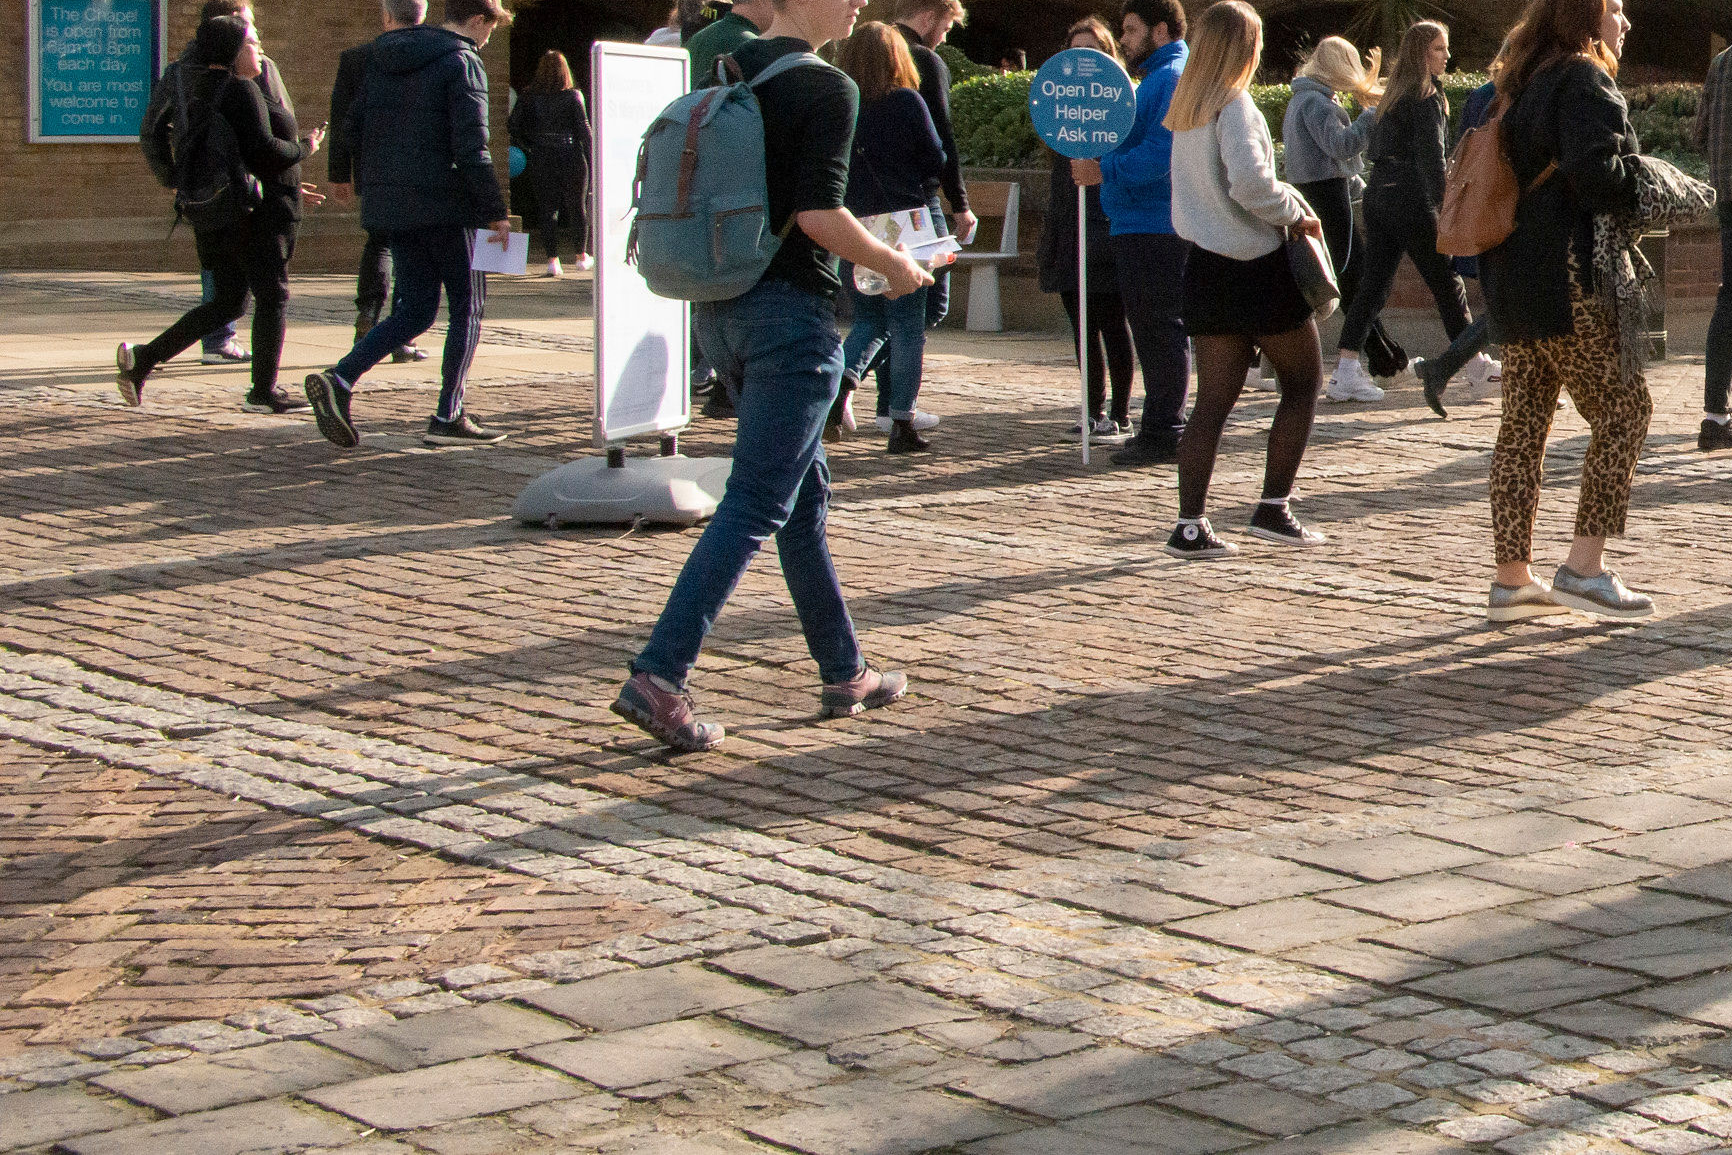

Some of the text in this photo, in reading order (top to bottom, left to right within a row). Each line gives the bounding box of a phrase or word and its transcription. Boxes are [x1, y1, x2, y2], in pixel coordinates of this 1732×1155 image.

[51, 6, 138, 25] The Chapel
[45, 24, 141, 40] is open from
[86, 40, 102, 54] to
[57, 58, 95, 72] each
[44, 78, 144, 92] You are most
[1042, 80, 1122, 102] Open Day
[49, 95, 138, 108] welcome to
[61, 114, 104, 125] come
[1055, 104, 1110, 124] Helper
[1056, 126, 1088, 142] Ask
[1092, 130, 1118, 144] me
